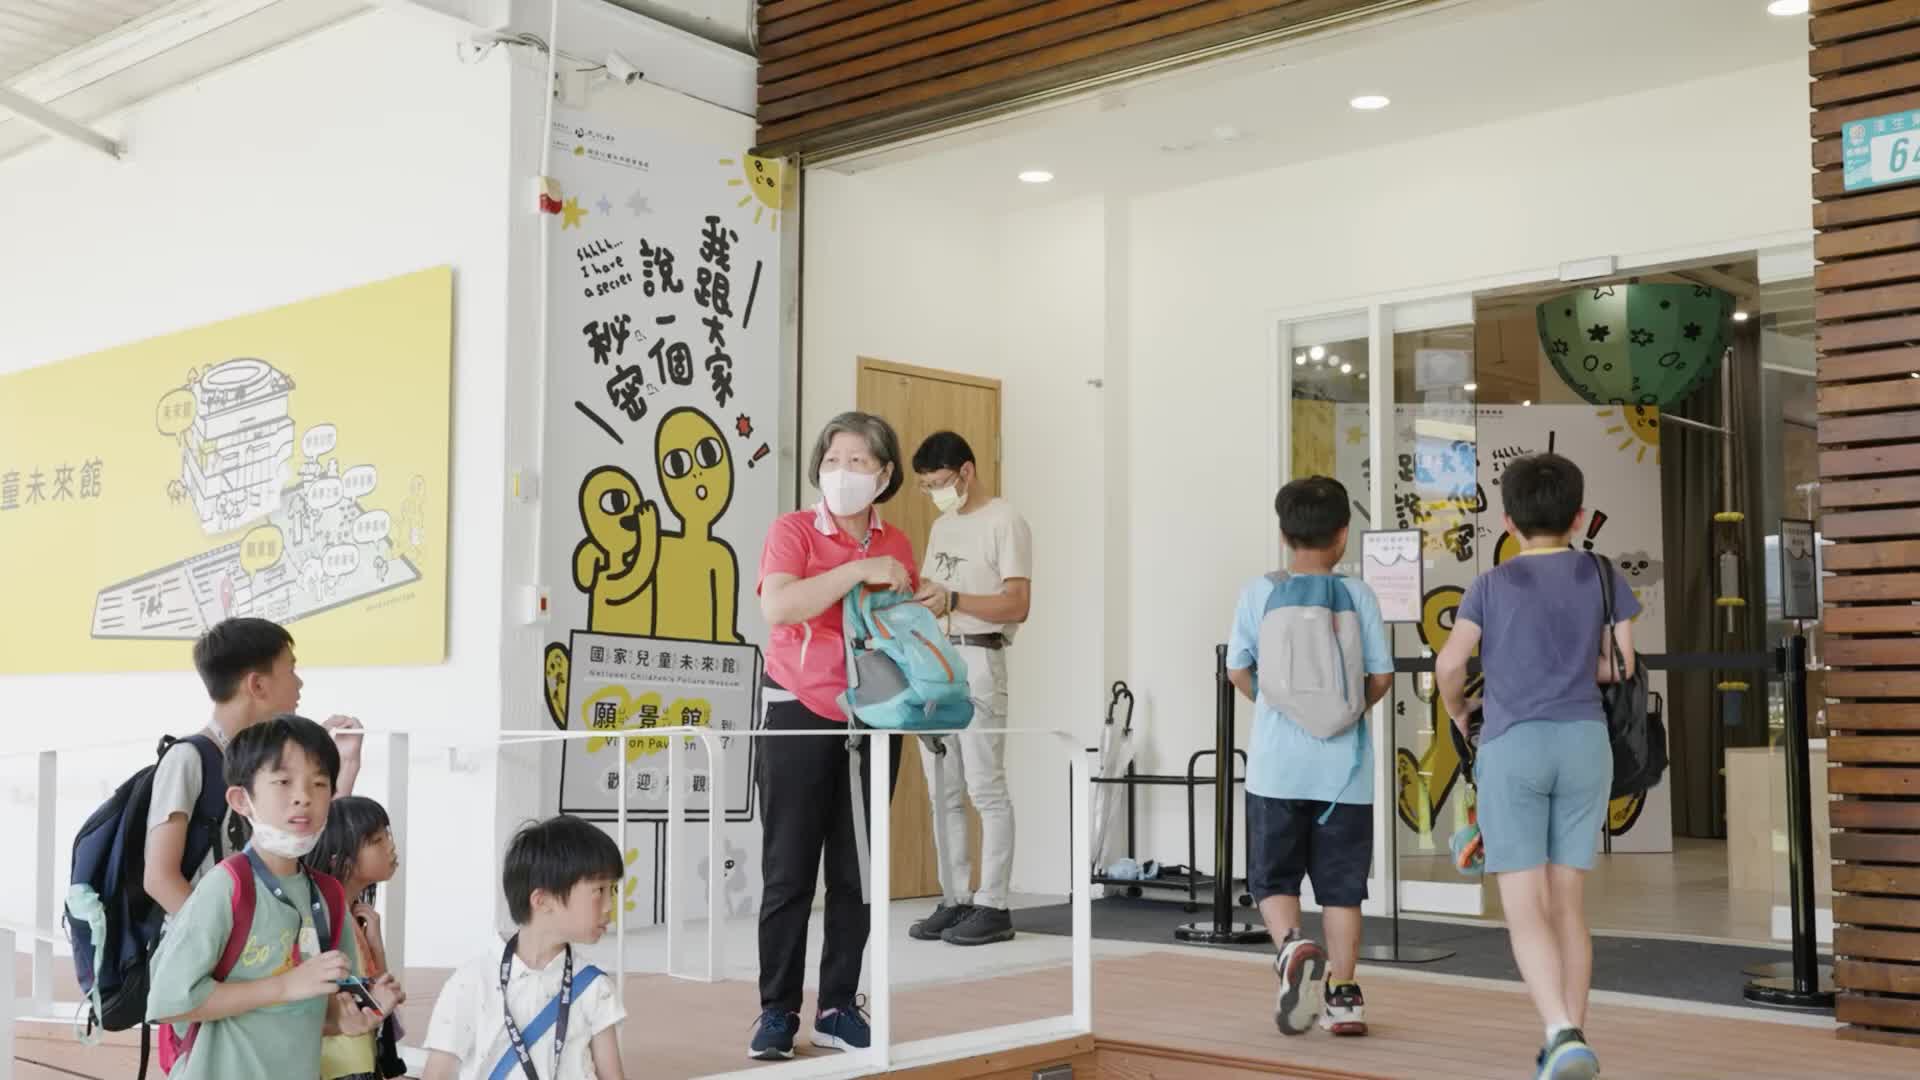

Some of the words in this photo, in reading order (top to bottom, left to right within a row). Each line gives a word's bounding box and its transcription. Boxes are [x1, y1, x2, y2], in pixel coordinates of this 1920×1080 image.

[580, 265, 590, 278] I
[591, 255, 624, 275] have
[584, 287, 595, 298] a
[596, 272, 633, 297] secret
[640, 238, 694, 387] 說一個
[695, 215, 738, 408] 我跟大家
[583, 314, 648, 422] 秘密
[590, 646, 736, 674] 國家兒童未來館
[592, 701, 704, 729] 願景館
[605, 736, 645, 749] Vion
[607, 771, 707, 793] 歡迎觀
